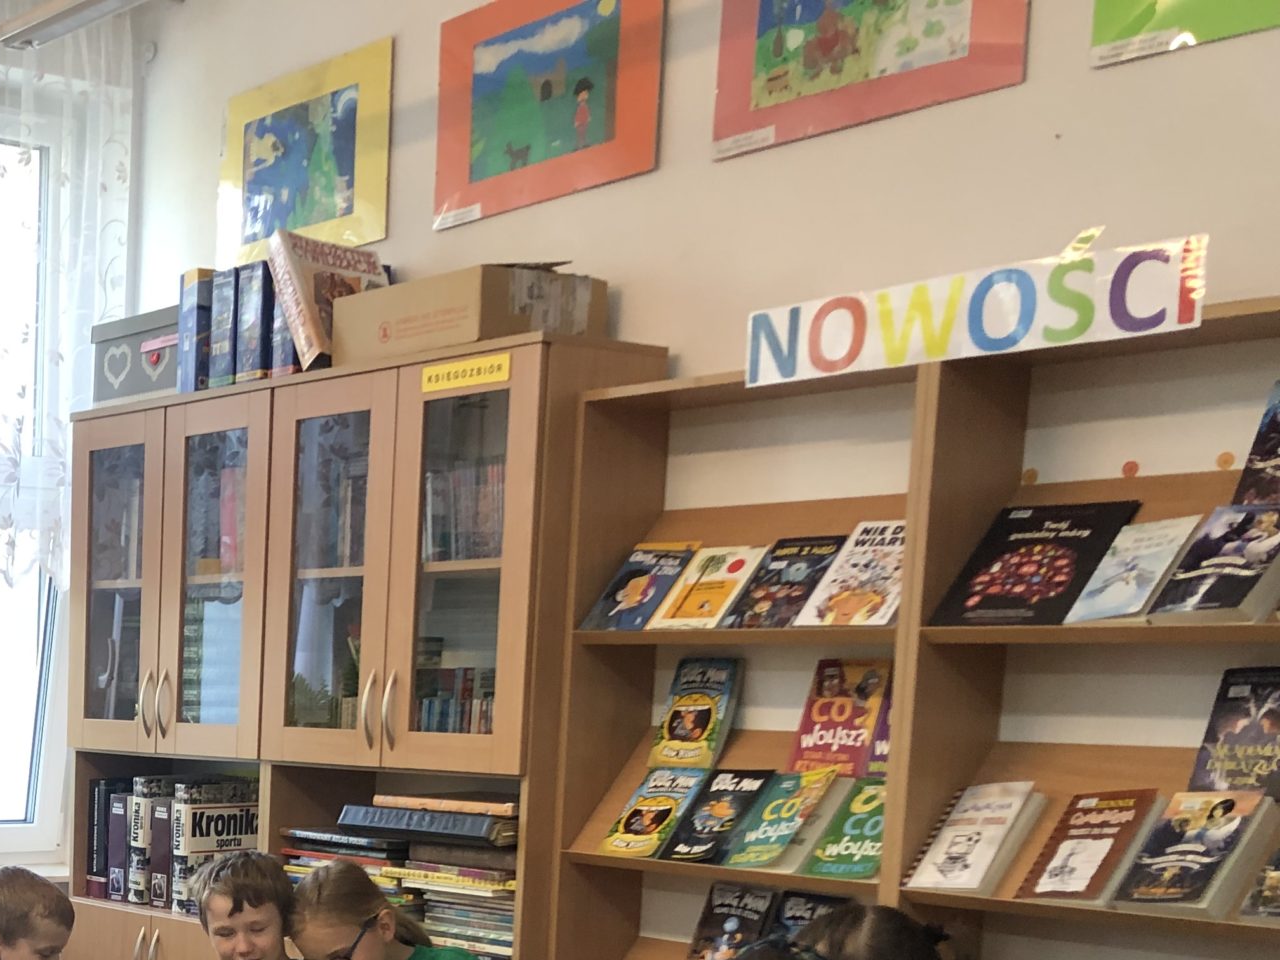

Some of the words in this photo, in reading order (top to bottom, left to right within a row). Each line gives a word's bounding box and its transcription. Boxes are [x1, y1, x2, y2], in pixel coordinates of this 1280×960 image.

[748, 226, 1207, 384] NOWOŚCI
[859, 526, 890, 536] NIE
[811, 697, 854, 722] CO
[131, 802, 141, 842] Kronika
[761, 798, 801, 821] CO
[174, 809, 183, 850] Kronika
[215, 837, 242, 848] sportu
